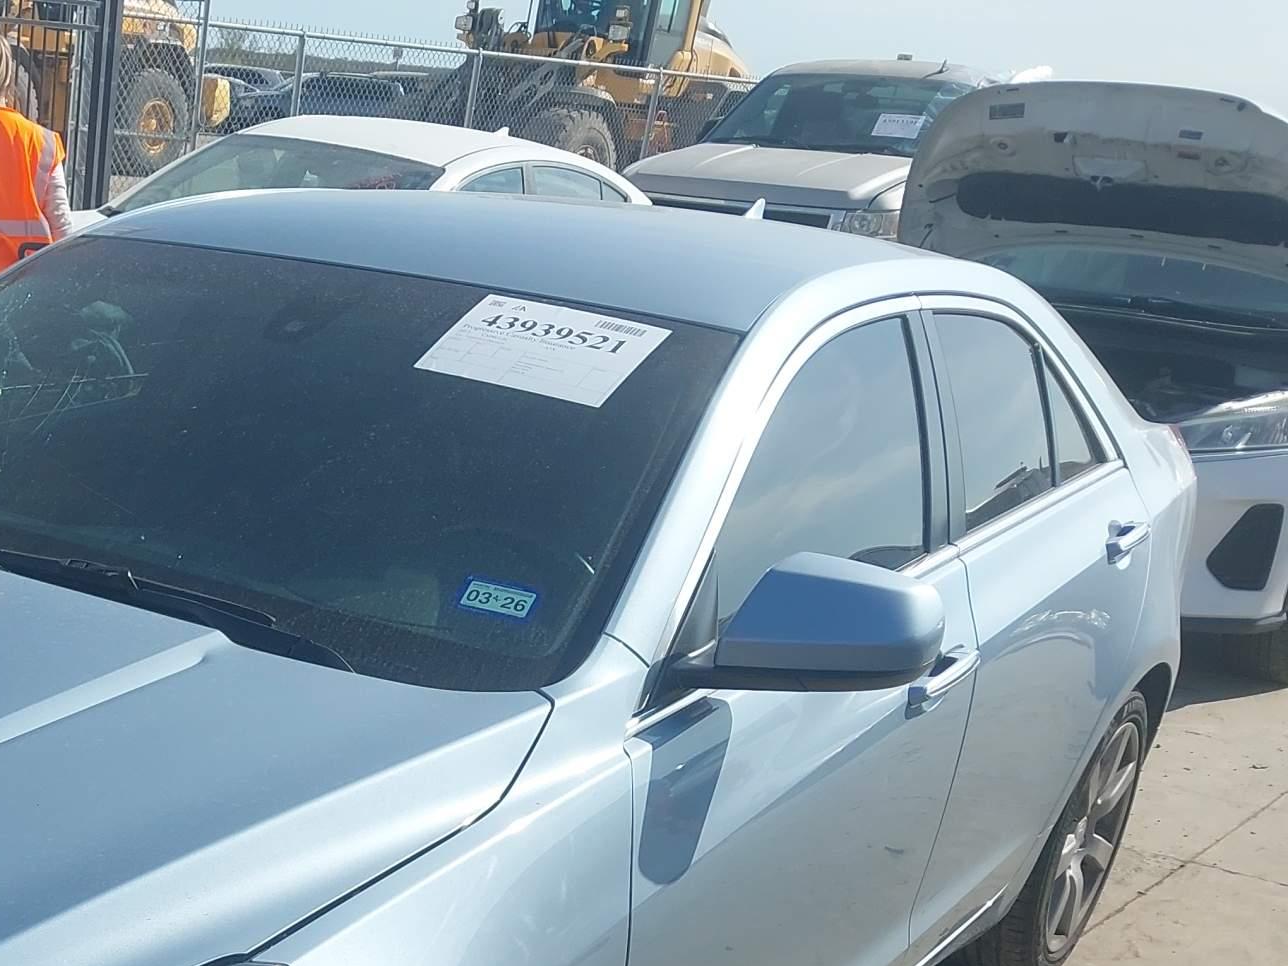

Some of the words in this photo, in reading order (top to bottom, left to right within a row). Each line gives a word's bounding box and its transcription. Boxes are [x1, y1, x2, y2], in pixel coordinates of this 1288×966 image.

[481, 313, 627, 354] 43939521
[466, 589, 493, 604] 03
[500, 597, 528, 612] 26
